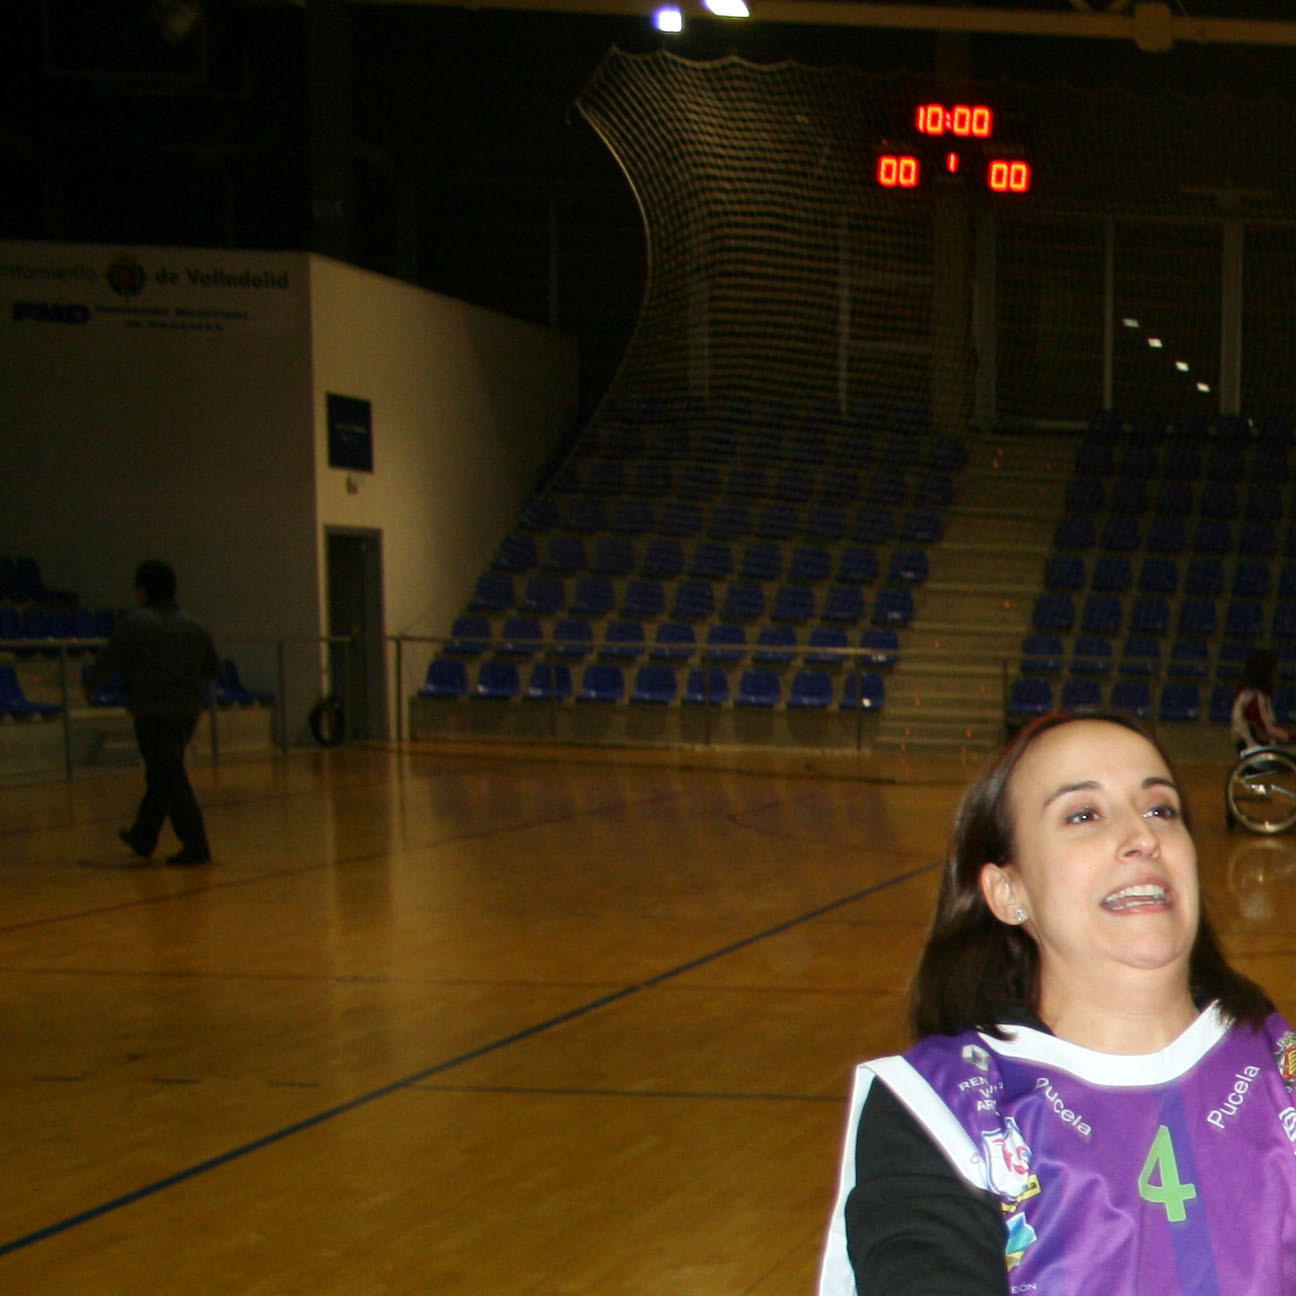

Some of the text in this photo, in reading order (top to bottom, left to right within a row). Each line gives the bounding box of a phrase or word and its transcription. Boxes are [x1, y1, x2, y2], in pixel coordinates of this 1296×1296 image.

[916, 103, 992, 136] 10:00
[877, 155, 919, 187] 00
[988, 160, 1030, 192] 00
[1207, 1062, 1260, 1131] Pucela
[1137, 1124, 1197, 1223] 4
